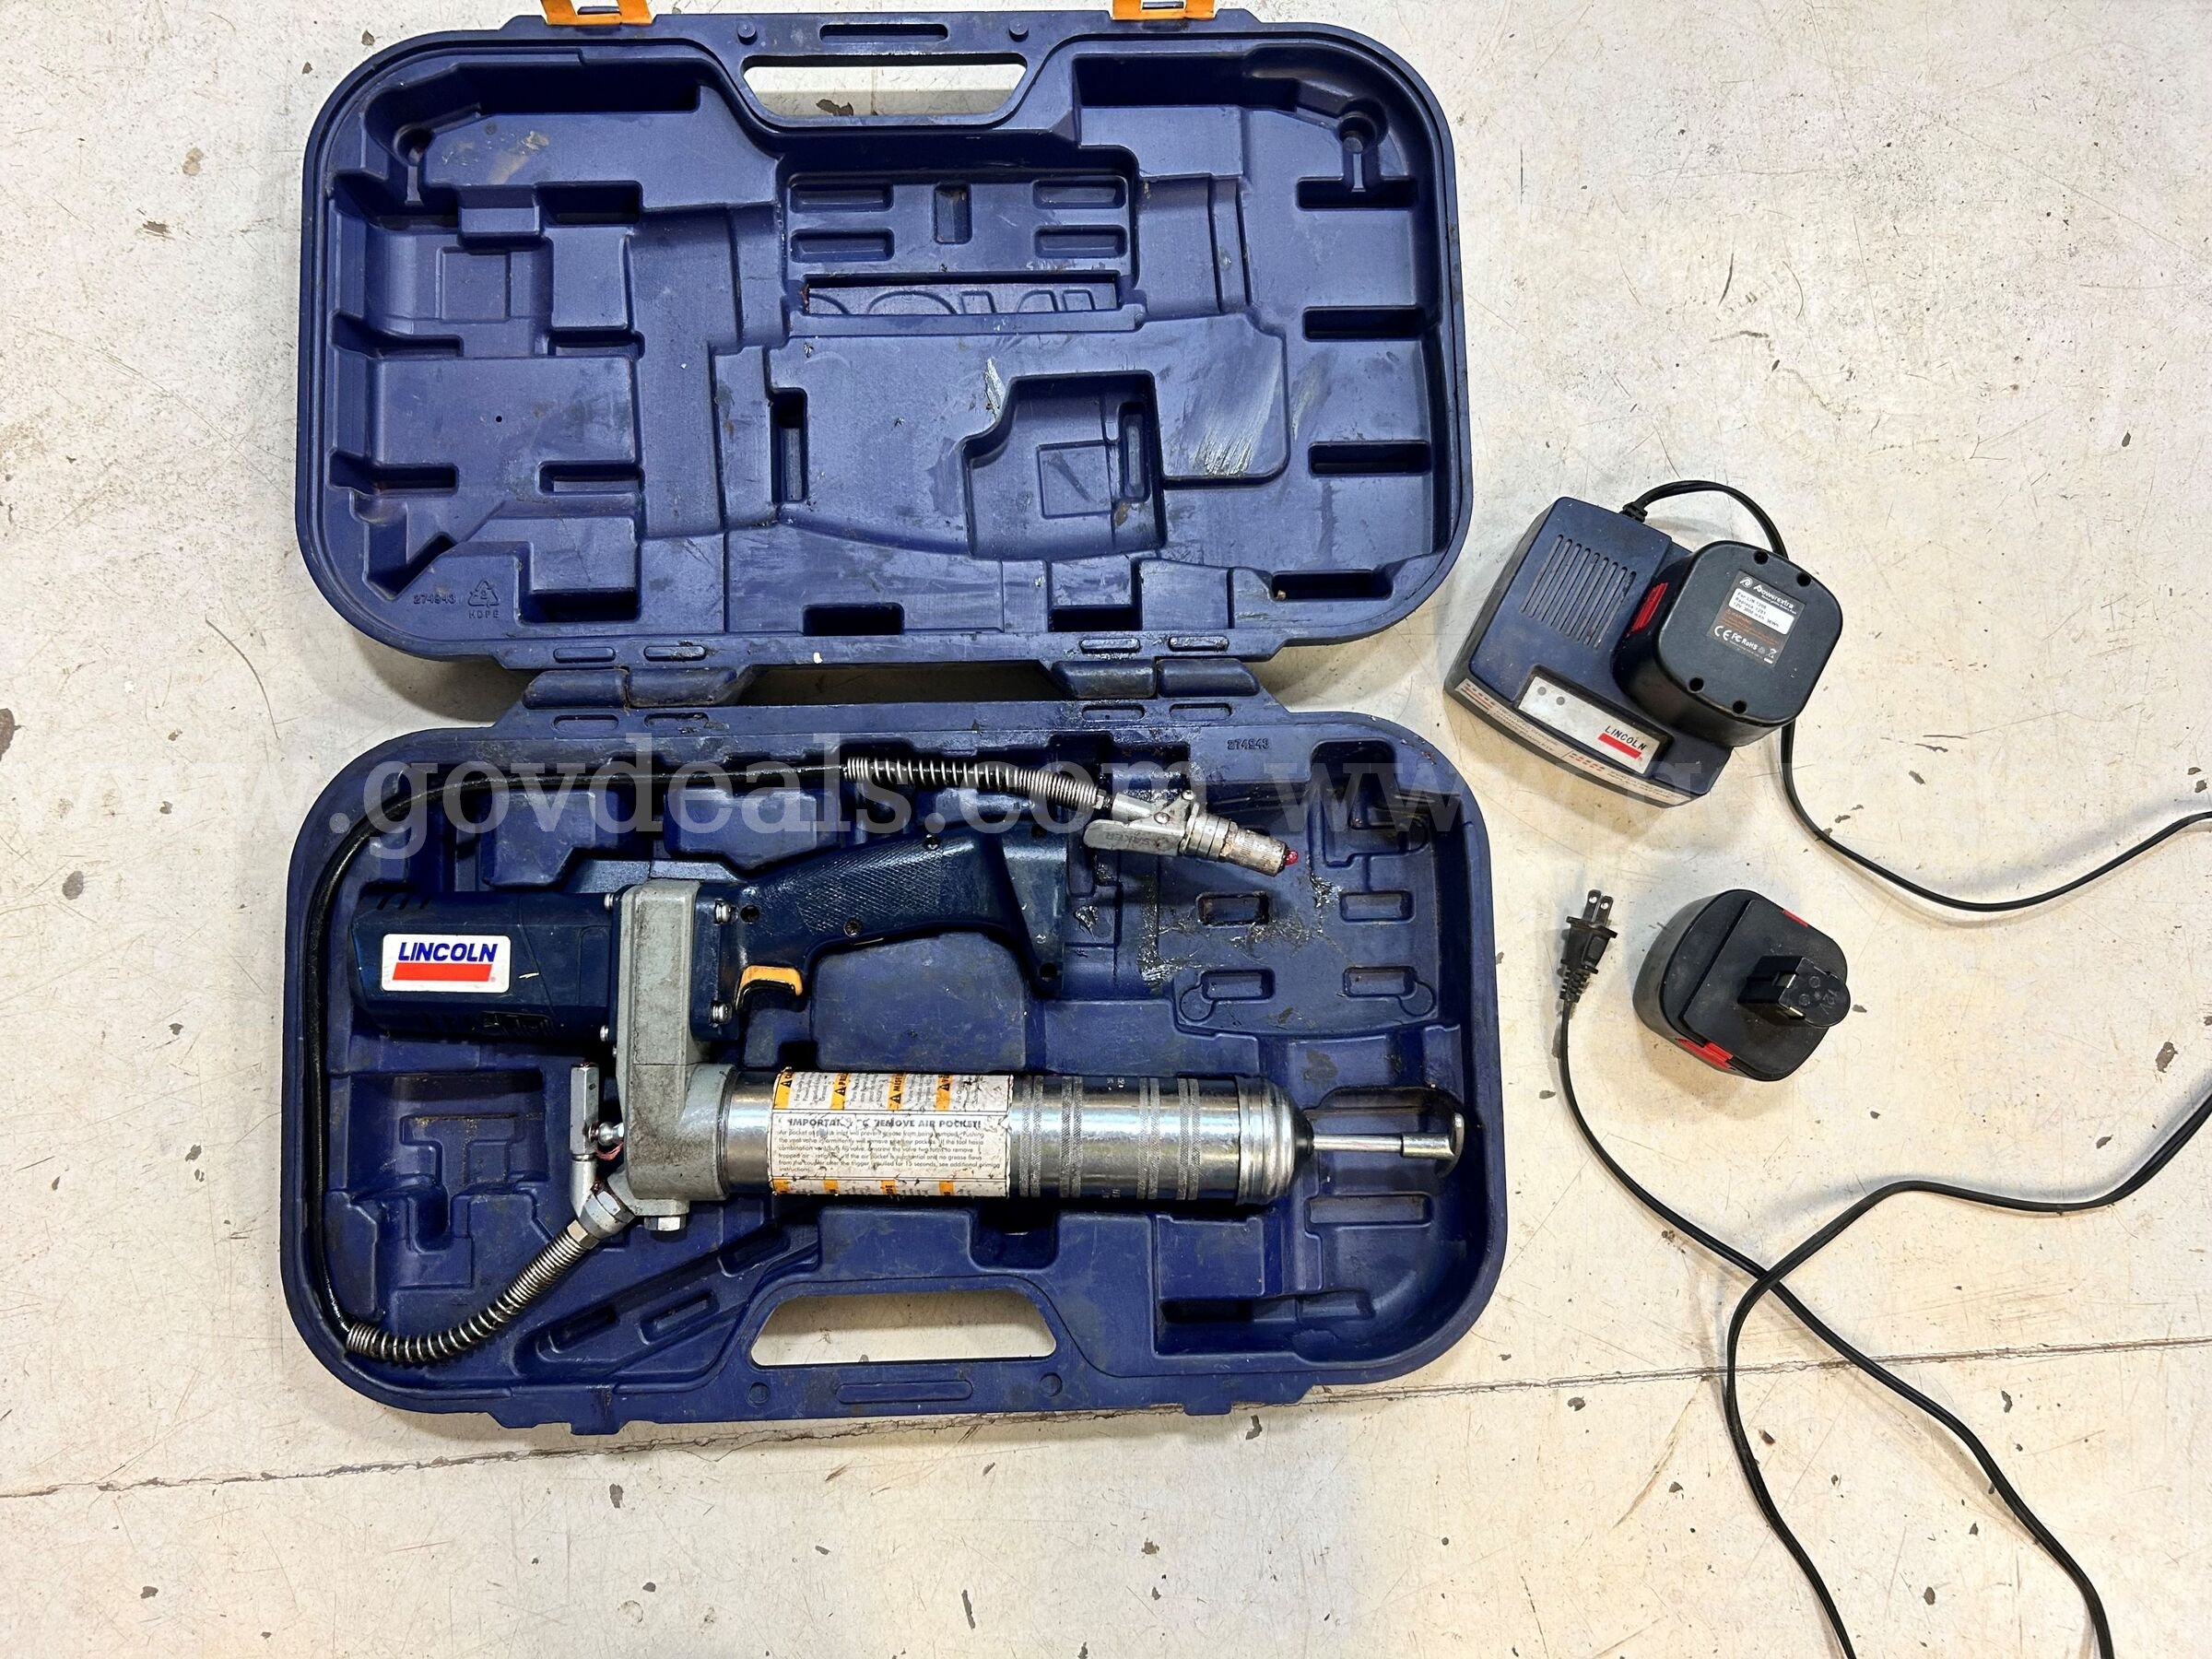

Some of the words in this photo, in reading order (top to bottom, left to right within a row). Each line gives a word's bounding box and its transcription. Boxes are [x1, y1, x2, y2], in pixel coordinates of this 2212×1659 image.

[1753, 584, 1794, 608] Powerextra
[469, 610, 500, 618] HDPE
[1605, 725, 1646, 750] LINCOLN
[398, 942, 499, 962] LINCOLN
[918, 1119, 935, 1127] AIR
